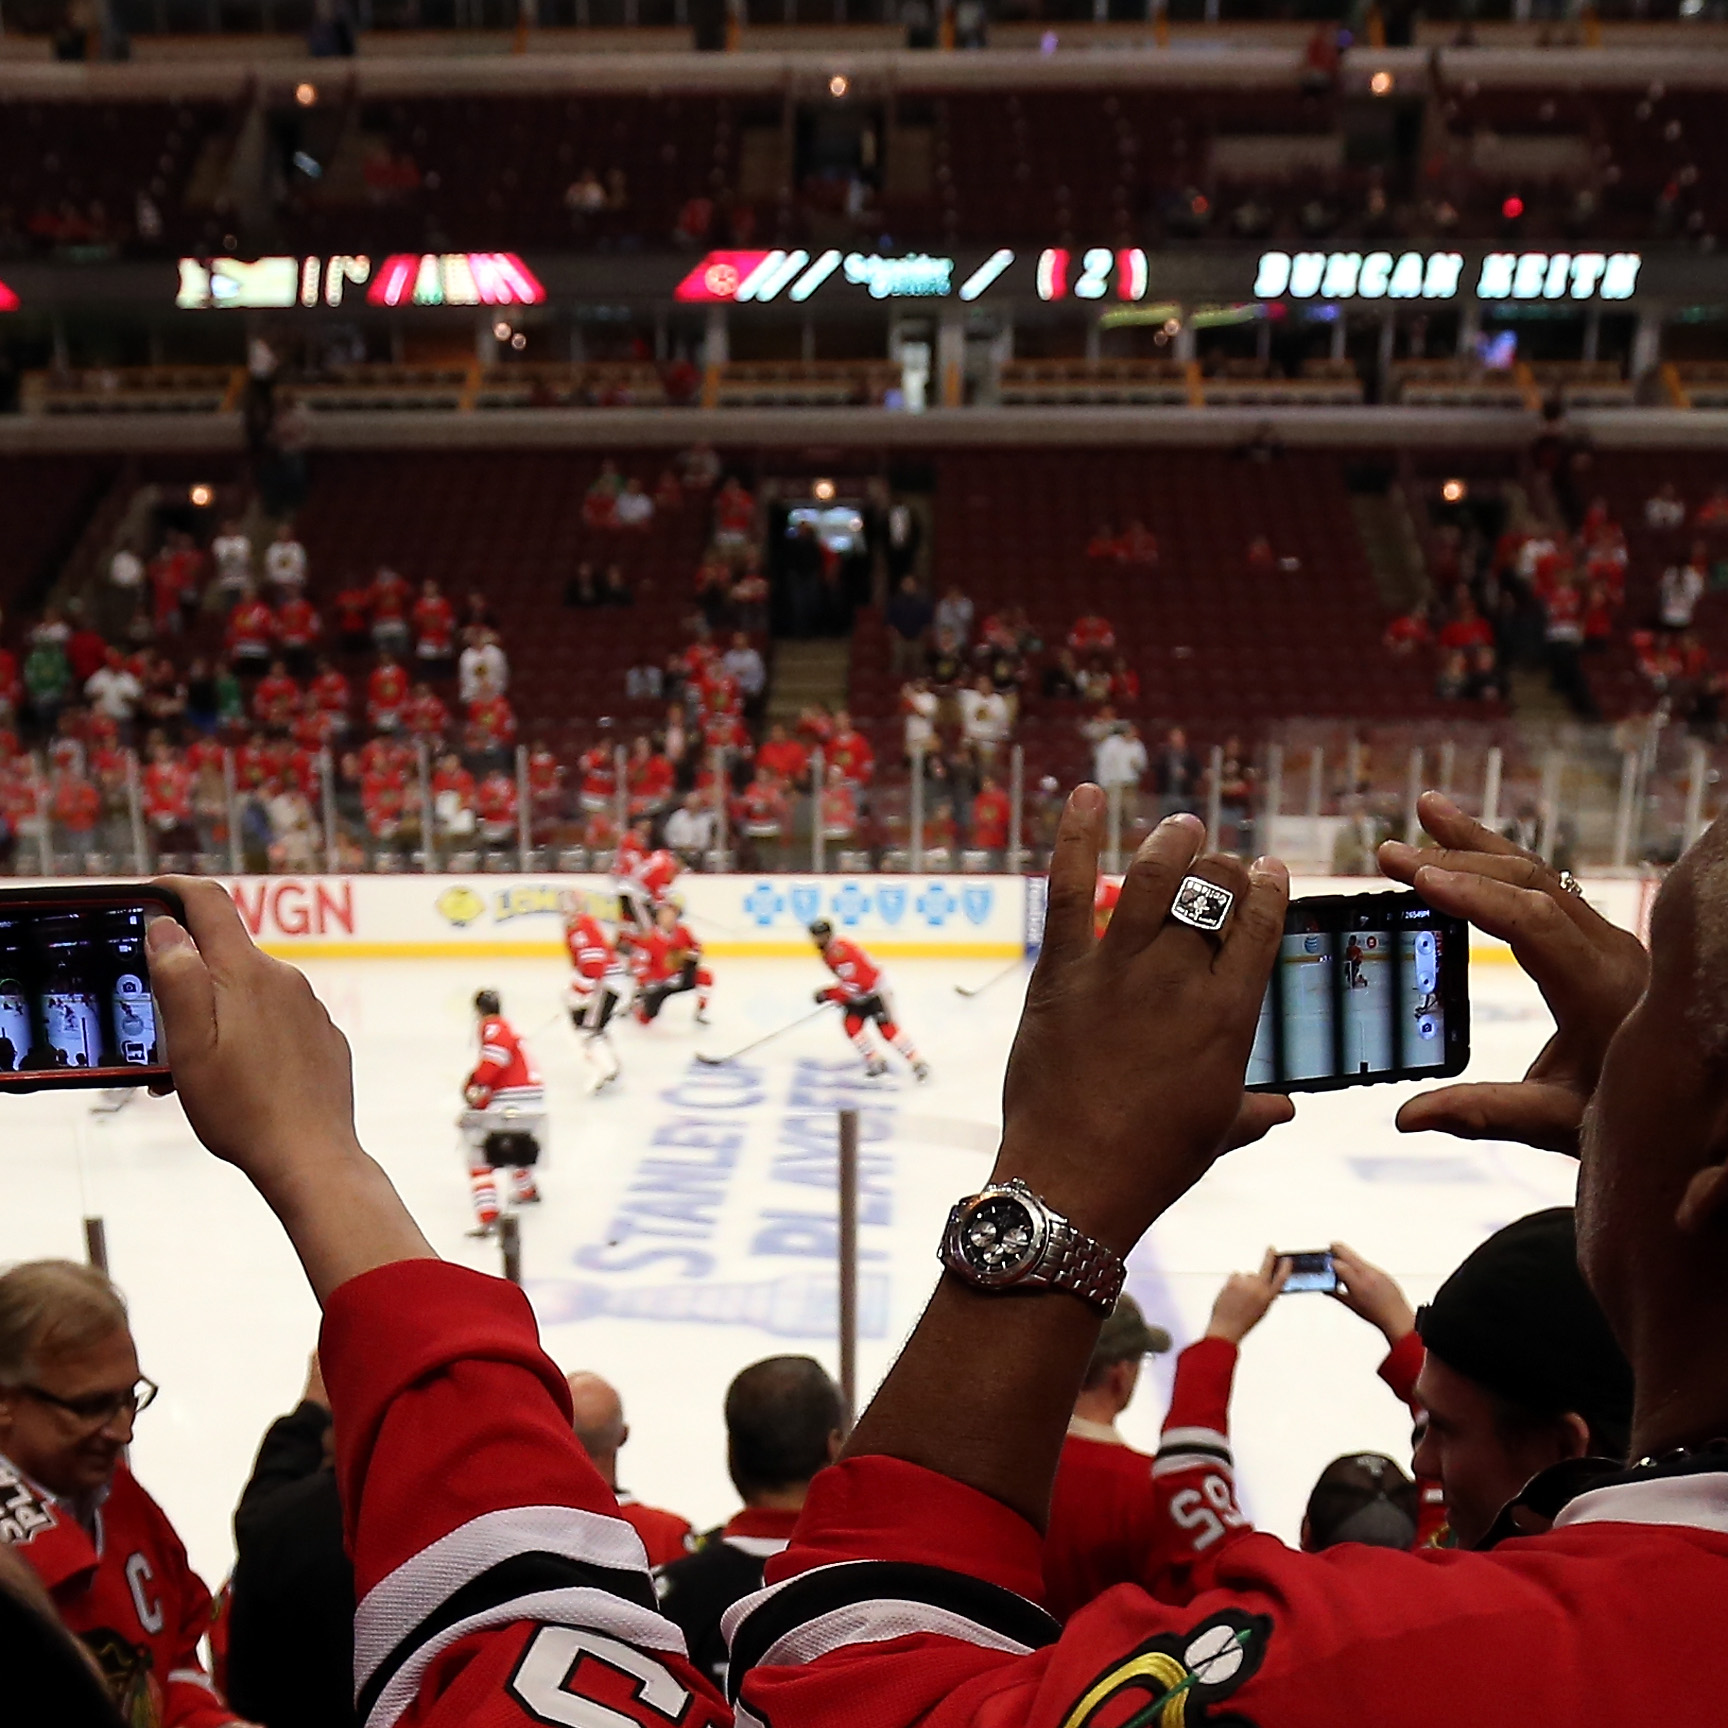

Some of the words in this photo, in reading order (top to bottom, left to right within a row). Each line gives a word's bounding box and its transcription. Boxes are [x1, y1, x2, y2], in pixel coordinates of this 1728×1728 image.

[1255, 250, 1462, 299] DUNCAN
[1478, 252, 1641, 299] KEITH
[126, 1552, 163, 1634] C
